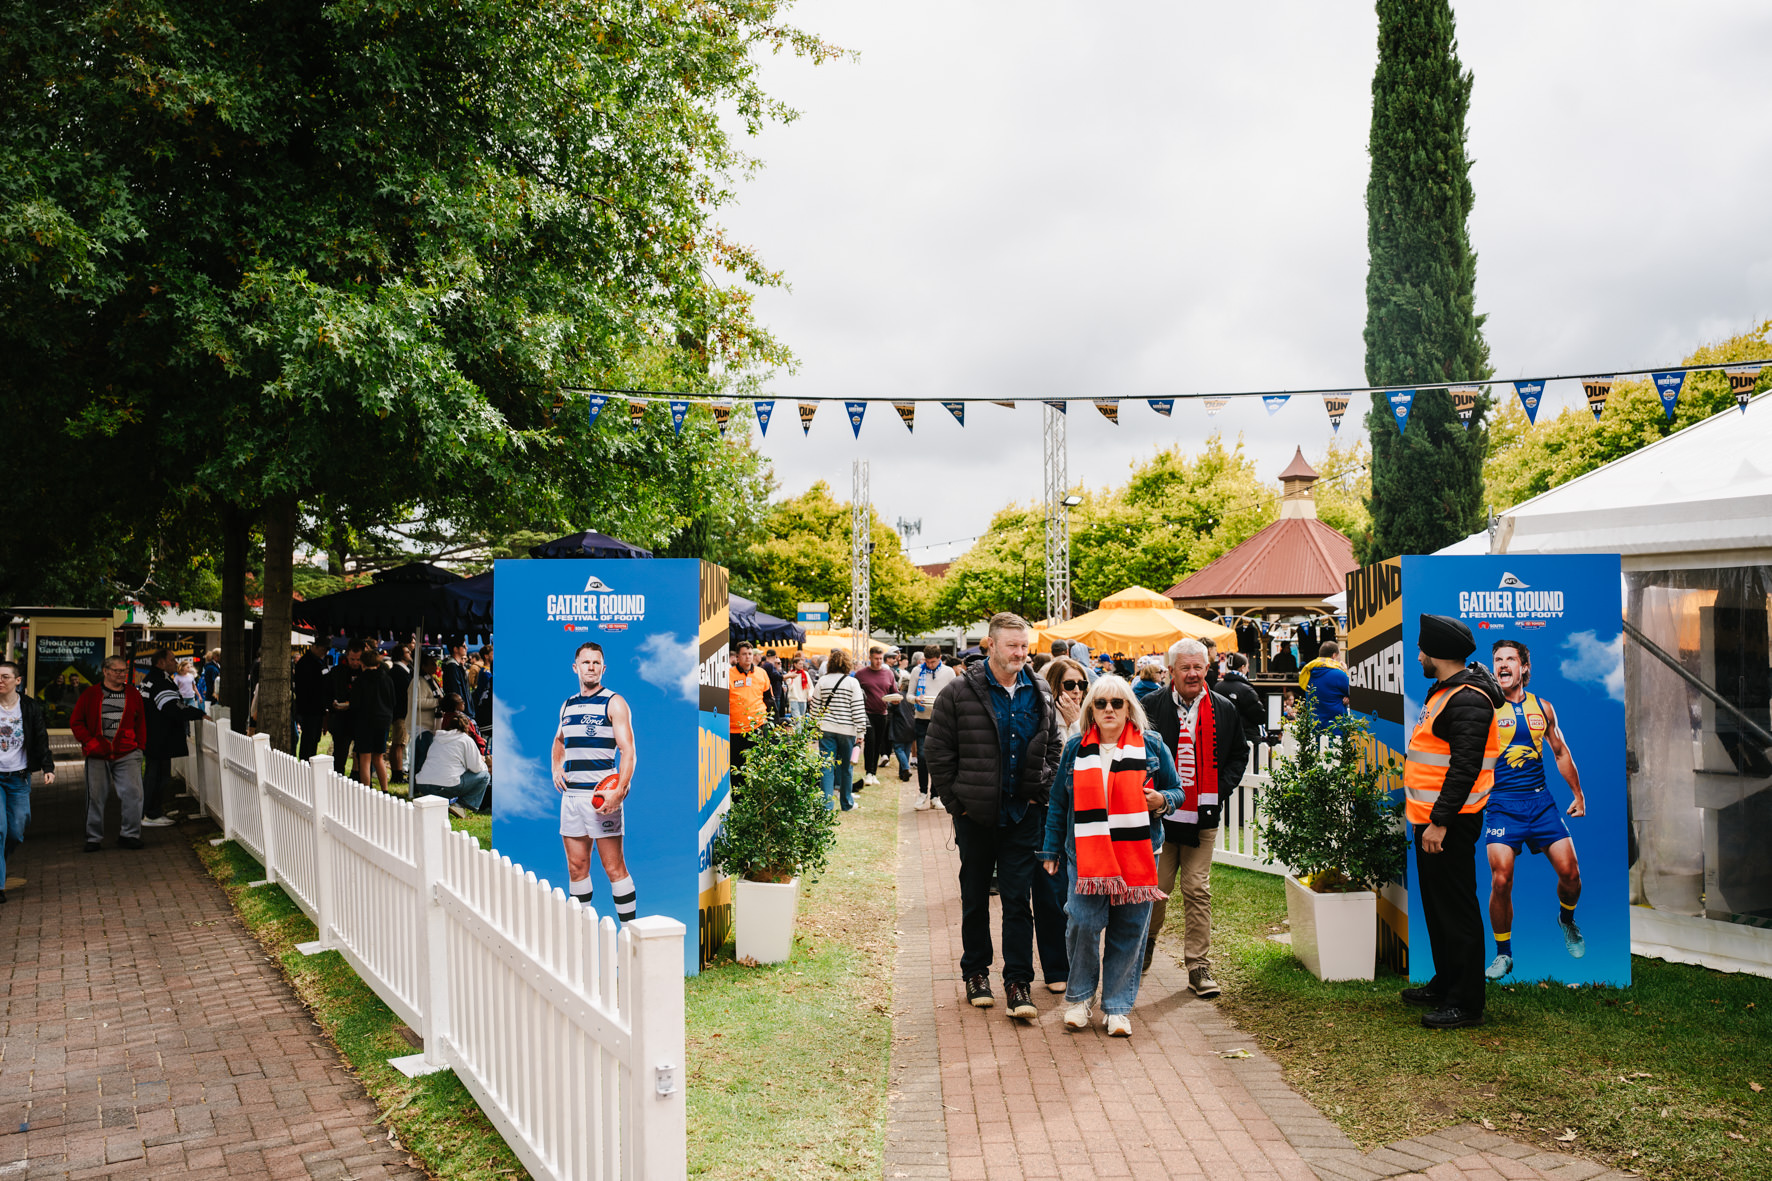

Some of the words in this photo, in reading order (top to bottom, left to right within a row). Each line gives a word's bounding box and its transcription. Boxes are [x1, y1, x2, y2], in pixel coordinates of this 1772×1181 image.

[547, 594, 597, 615] GATHER
[599, 594, 645, 615] ROUND
[699, 559, 730, 625] ROUND
[1345, 562, 1402, 633] ROUND
[1459, 591, 1513, 612] GATHER
[1515, 590, 1564, 612] ROUND
[39, 639, 67, 647] Shout
[1348, 640, 1404, 695] GATHER
[580, 714, 604, 726] Ford
[698, 726, 731, 813] ROUND
[1177, 743, 1196, 787] KILDA
[1491, 826, 1505, 838] agl
